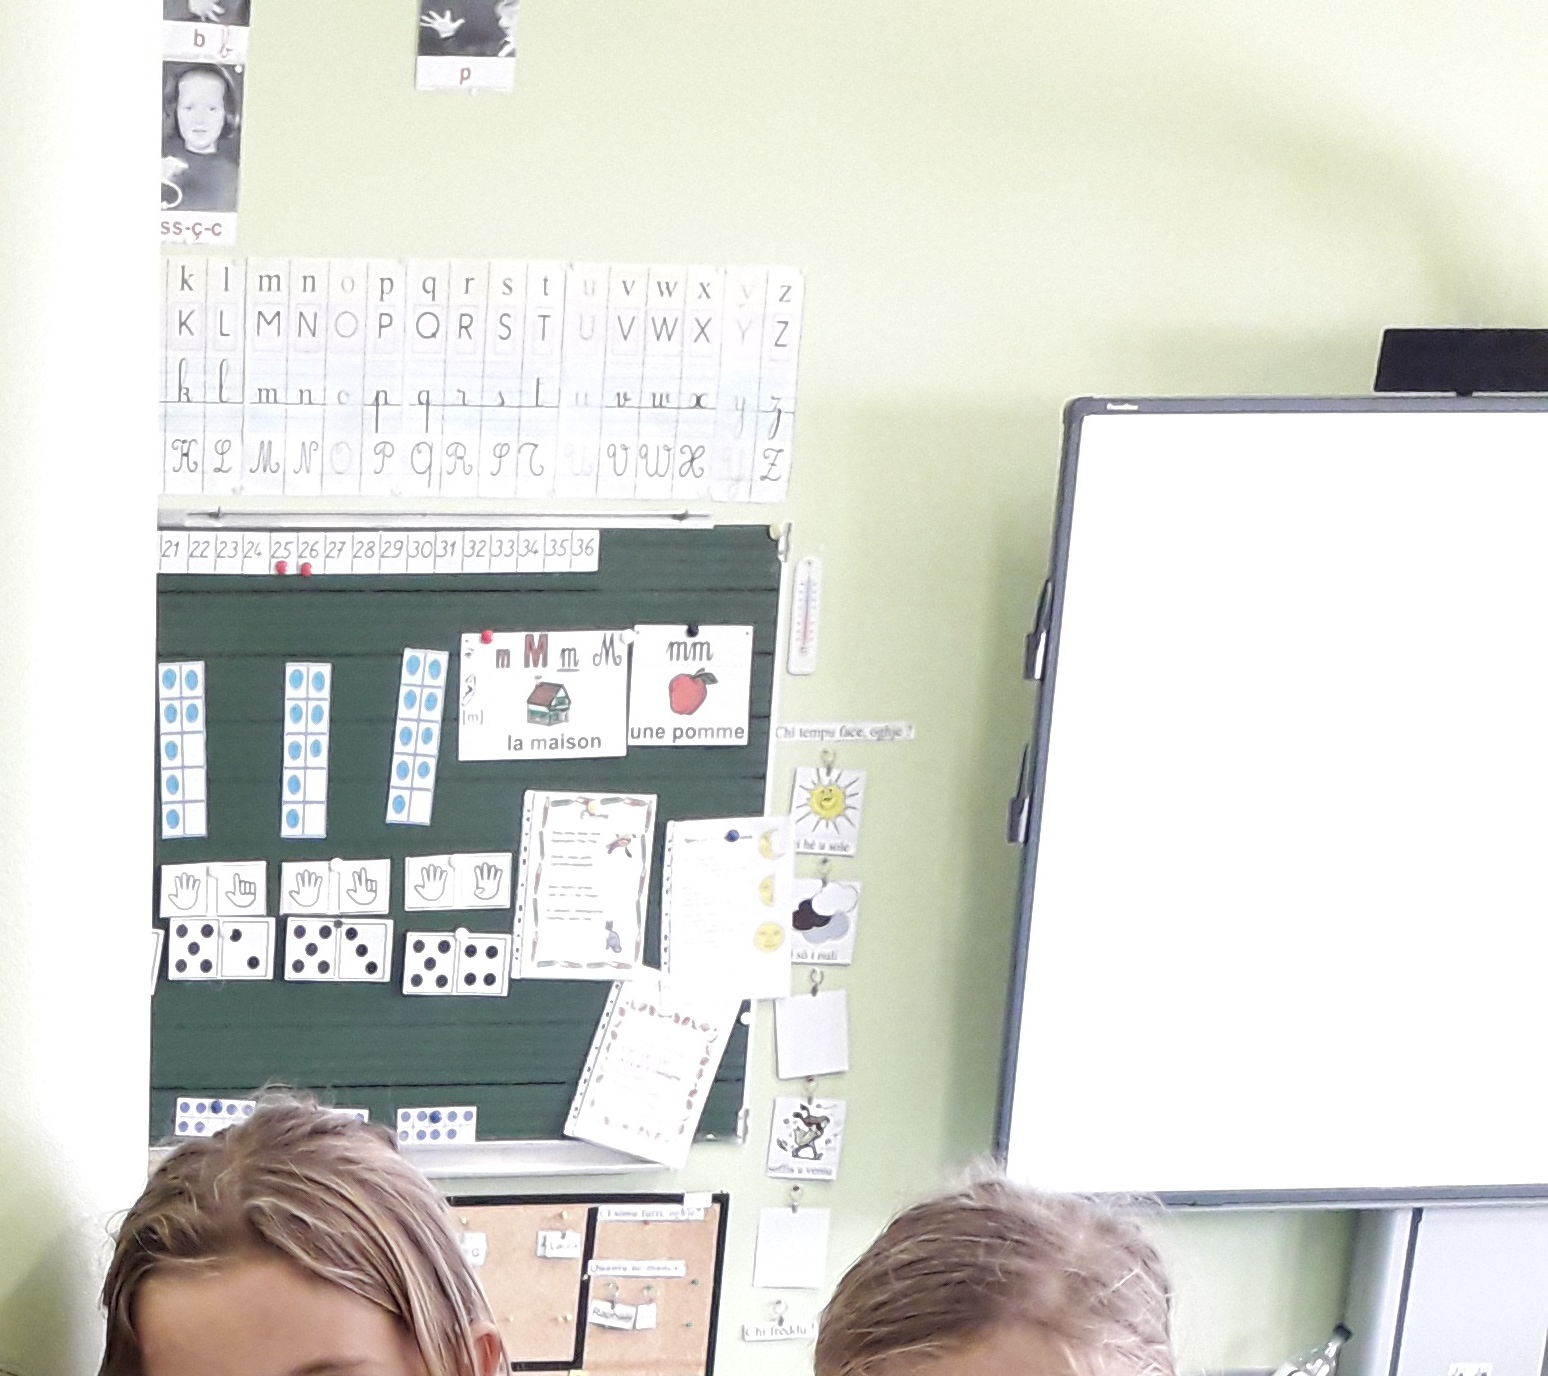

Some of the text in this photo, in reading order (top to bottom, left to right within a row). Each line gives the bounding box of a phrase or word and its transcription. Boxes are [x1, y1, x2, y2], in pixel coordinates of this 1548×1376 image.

[194, 29, 205, 47] b
[460, 66, 471, 84] p
[180, 265, 194, 291] k
[224, 267, 229, 291] l
[259, 274, 281, 292] m
[302, 274, 316, 292] n
[379, 277, 393, 301] p
[422, 277, 436, 301] q
[464, 277, 475, 294] r
[502, 278, 513, 295] s
[543, 276, 549, 296] t
[622, 280, 635, 296] v
[657, 281, 677, 297] w
[698, 283, 711, 299] x
[779, 285, 792, 302] z
[178, 310, 195, 336] K
[220, 310, 230, 336] L
[257, 311, 280, 336] M
[298, 312, 317, 337] N
[335, 311, 358, 337] O
[378, 313, 392, 338] P
[416, 312, 439, 339] Q
[459, 313, 473, 340] R
[499, 314, 511, 340] S
[538, 315, 551, 341] T
[618, 316, 635, 341] V
[652, 317, 678, 341] W
[694, 317, 712, 342] X
[774, 321, 789, 347] Z
[162, 538, 594, 559] 21 22 23 24 25 26 27 28 29 30 31 32 33 34 35 36
[496, 633, 622, 668] m M m M
[508, 733, 601, 751] la maison
[631, 726, 745, 743] une pomme
